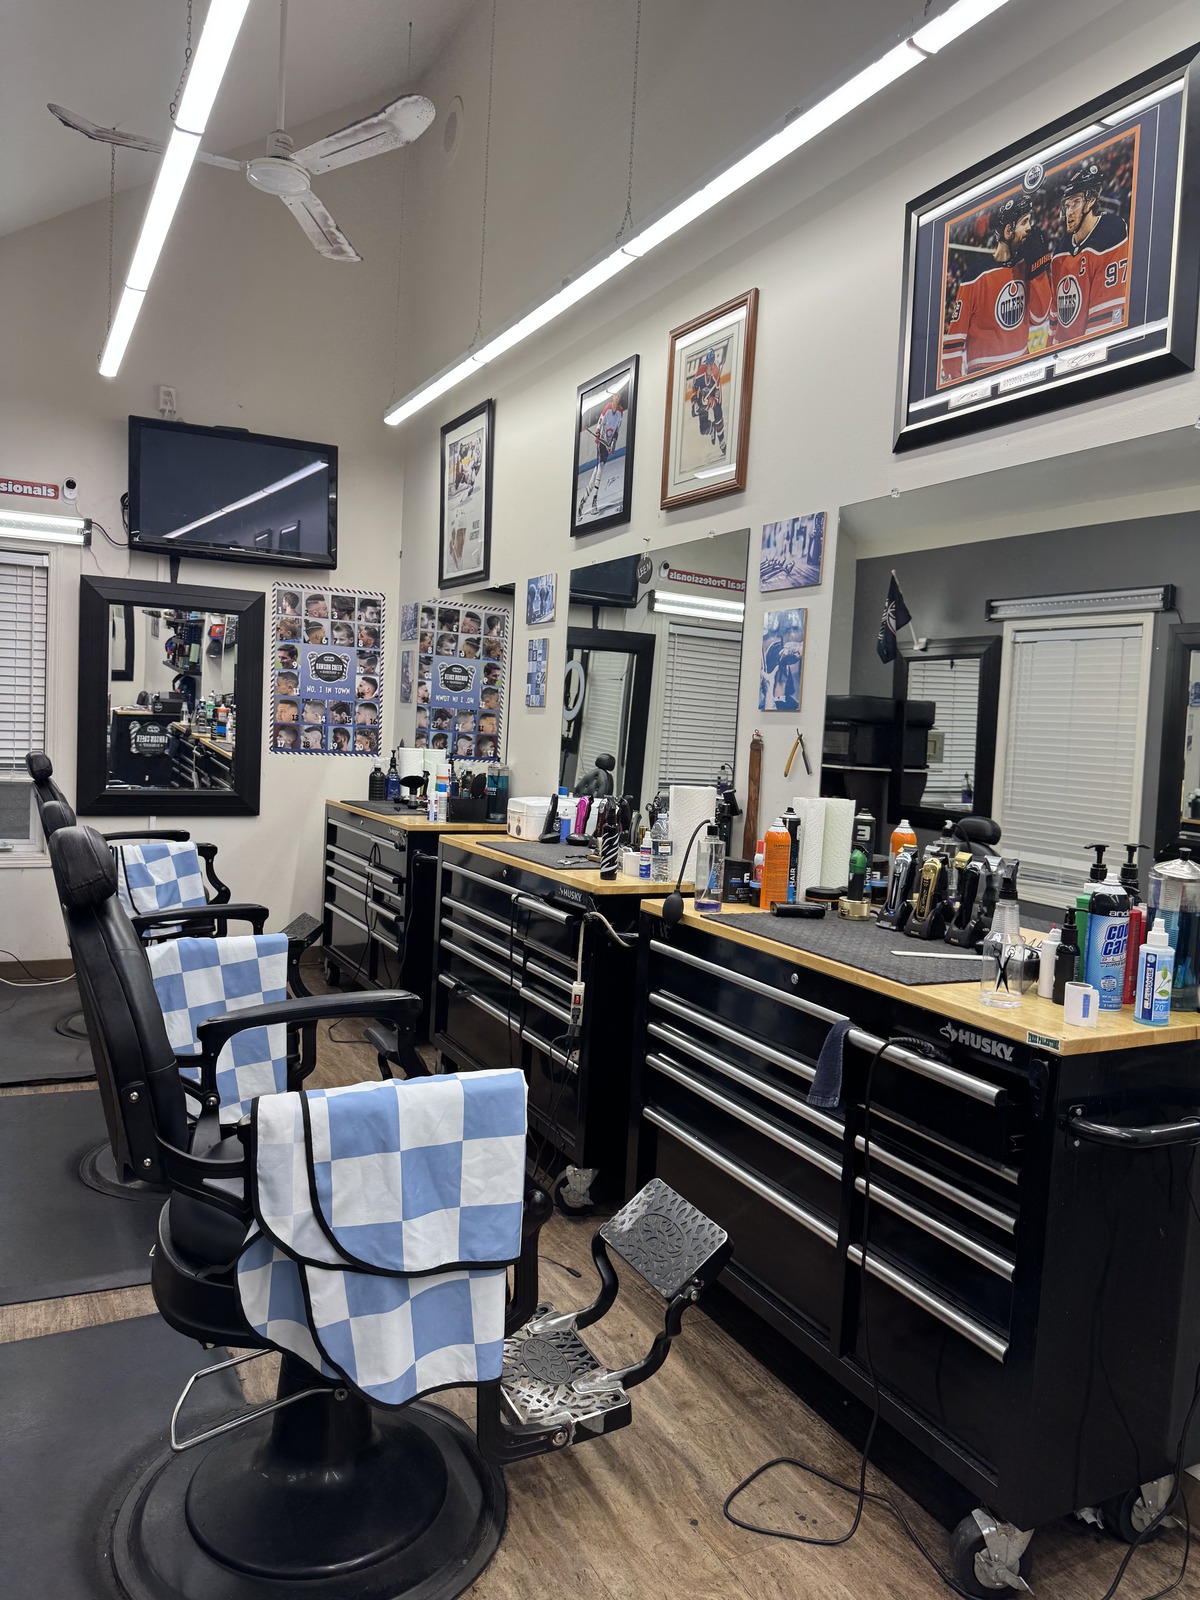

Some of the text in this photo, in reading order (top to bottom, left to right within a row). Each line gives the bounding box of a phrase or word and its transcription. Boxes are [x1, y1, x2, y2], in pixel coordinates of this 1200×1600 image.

[1000, 296, 1024, 312] OILERS
[0, 481, 56, 498] sionals
[563, 890, 583, 902] HUSKY
[958, 1029, 1015, 1062] HUSKY
